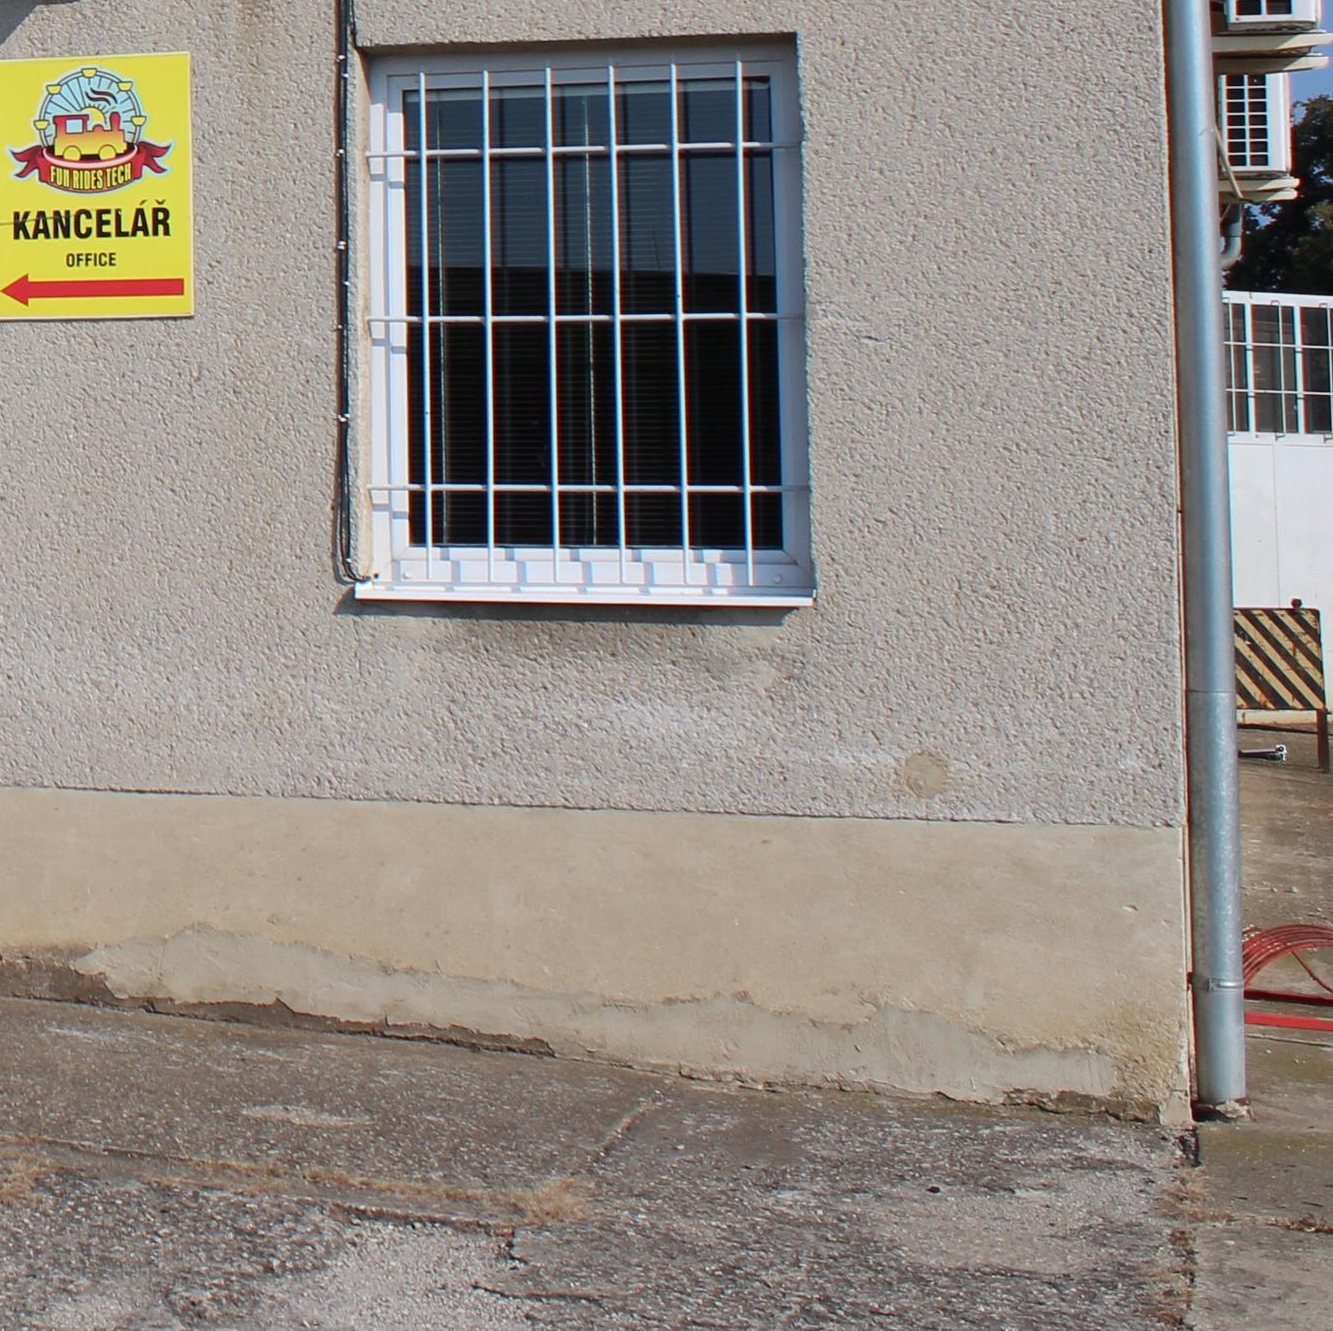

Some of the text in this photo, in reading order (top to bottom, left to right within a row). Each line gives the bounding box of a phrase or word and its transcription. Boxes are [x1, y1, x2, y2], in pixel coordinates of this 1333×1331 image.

[50, 162, 131, 190] FUN RIDES TECH
[12, 199, 171, 240] KANCELÁŘ
[65, 252, 117, 268] OFFICE
